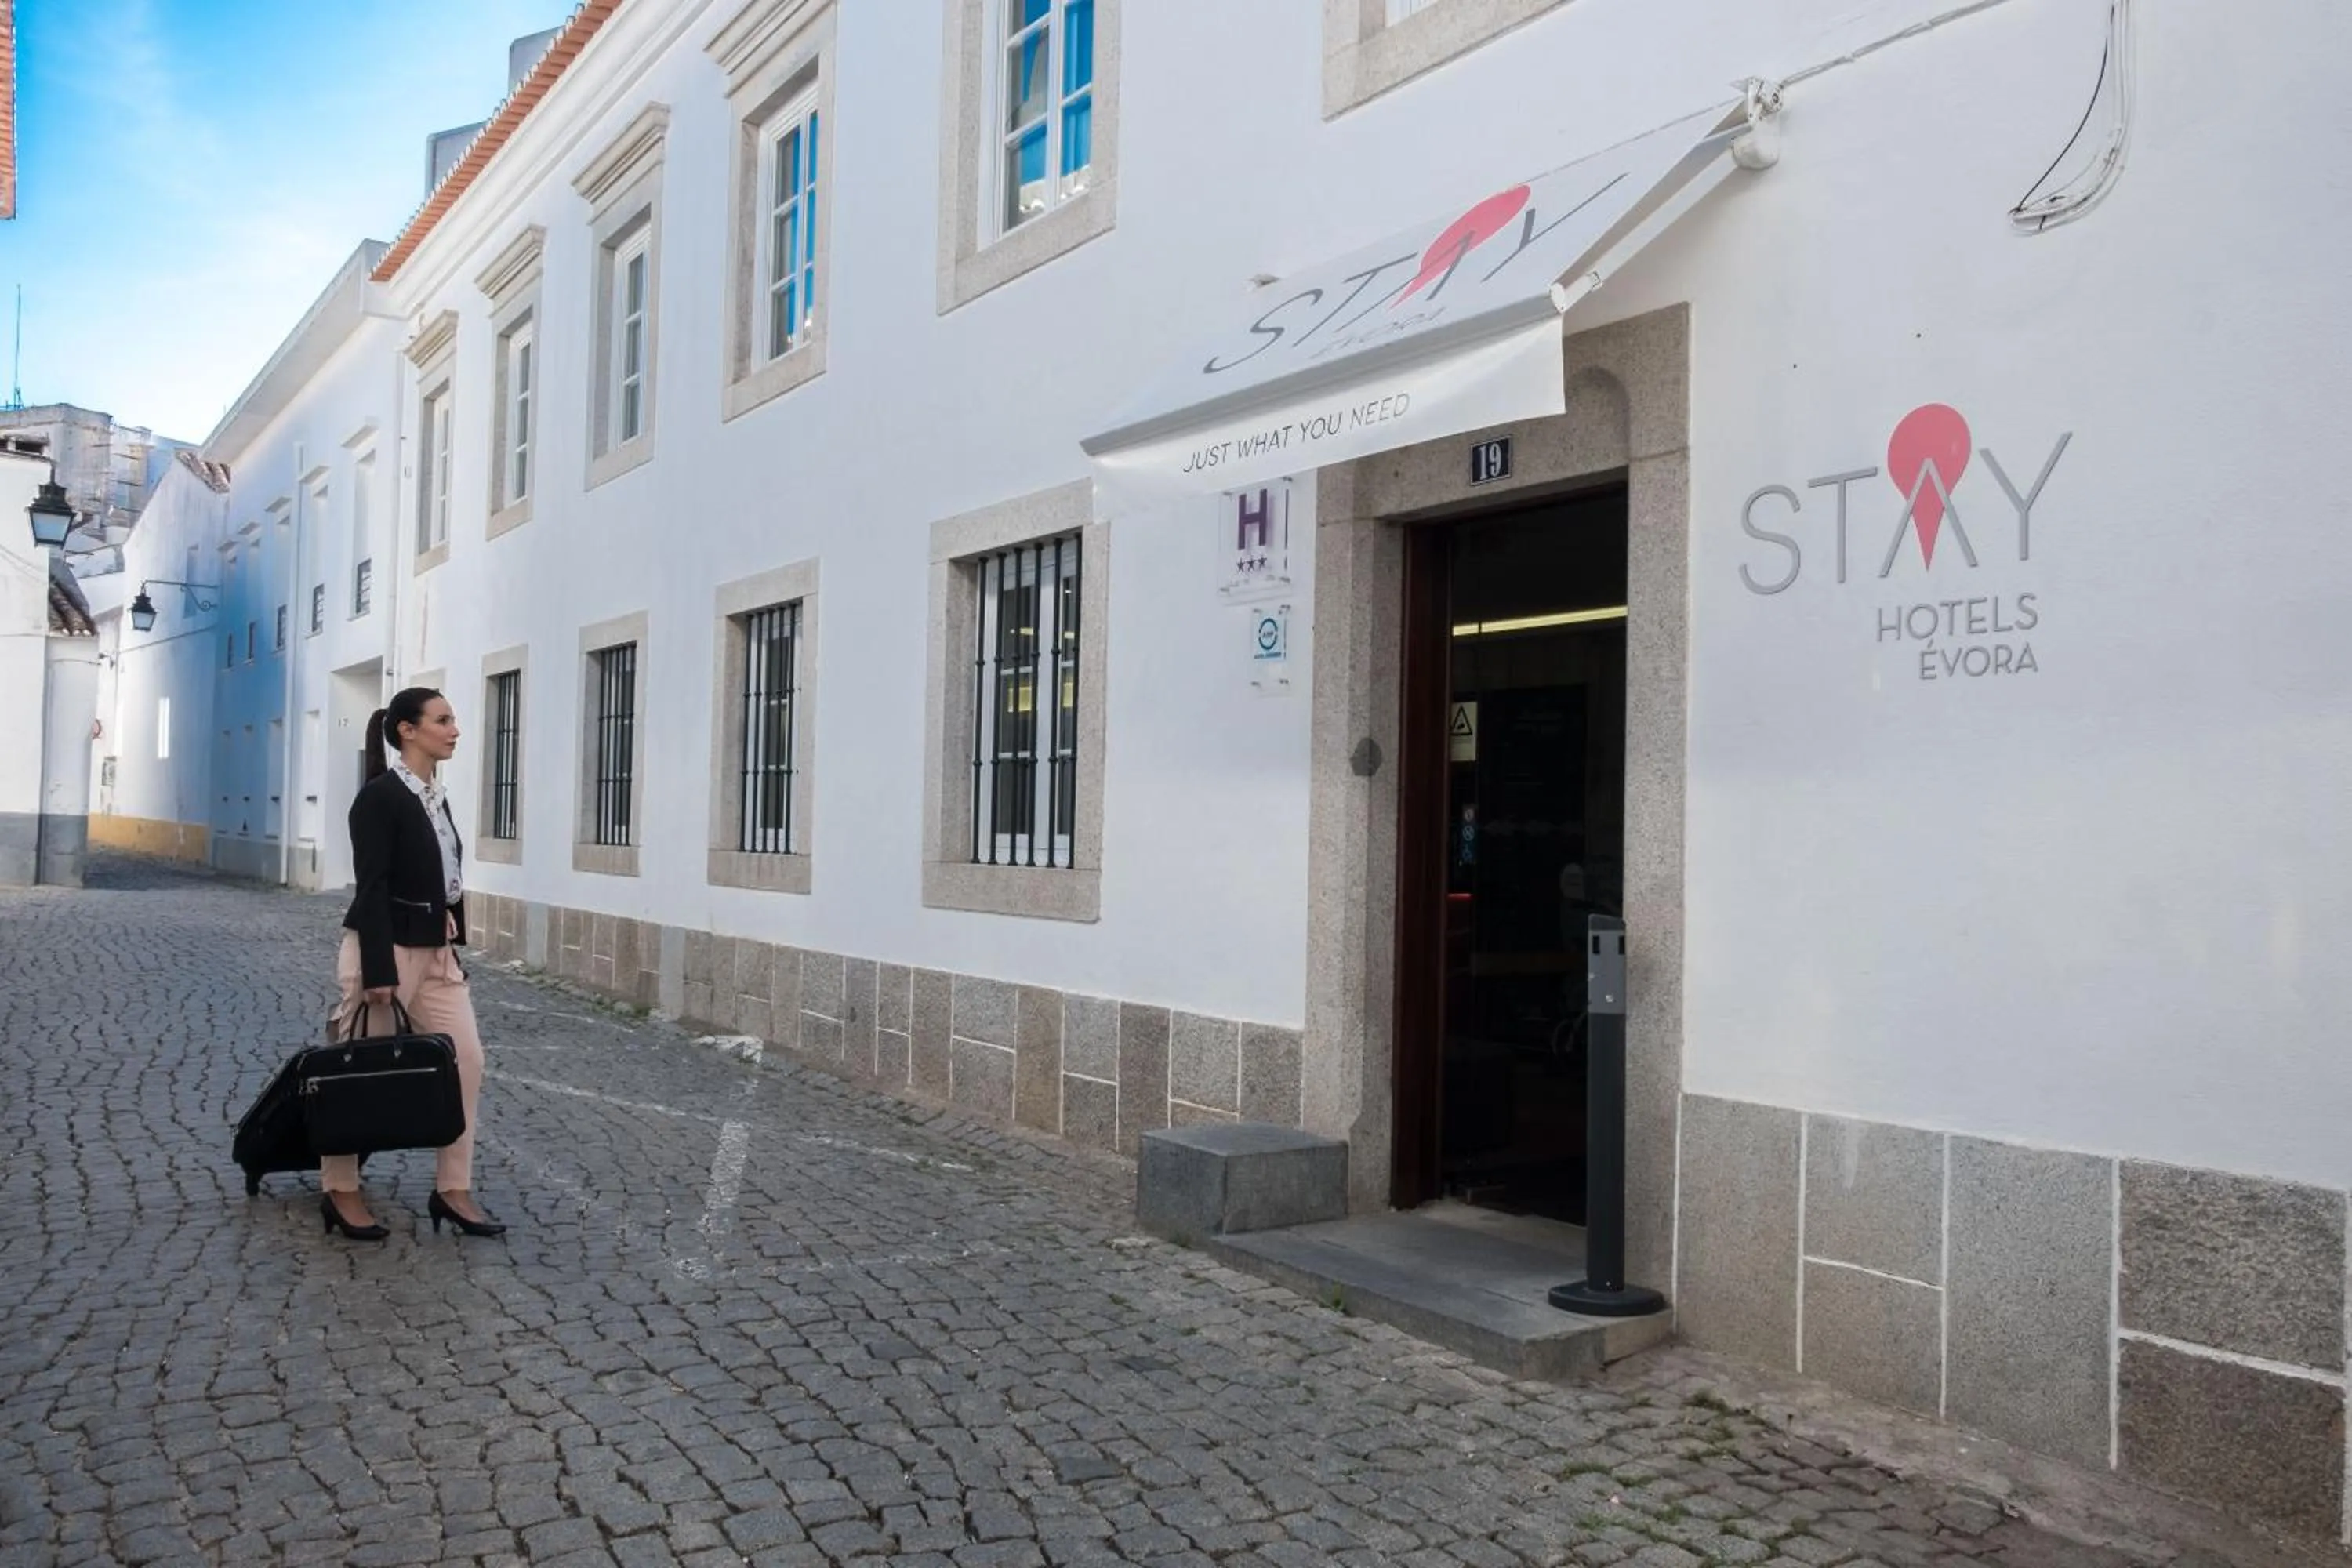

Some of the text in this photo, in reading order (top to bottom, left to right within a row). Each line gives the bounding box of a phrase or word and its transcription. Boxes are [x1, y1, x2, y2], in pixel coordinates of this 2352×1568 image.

[1203, 172, 1630, 374] STAY
[1183, 393, 1410, 473] JUST WHAT YOU NEED
[1479, 443, 1501, 480] 19
[1238, 488, 1267, 550] H
[1738, 430, 2073, 596] STAY
[1876, 593, 2038, 642] HOTELS
[1919, 640, 2038, 680] ÉVORA
